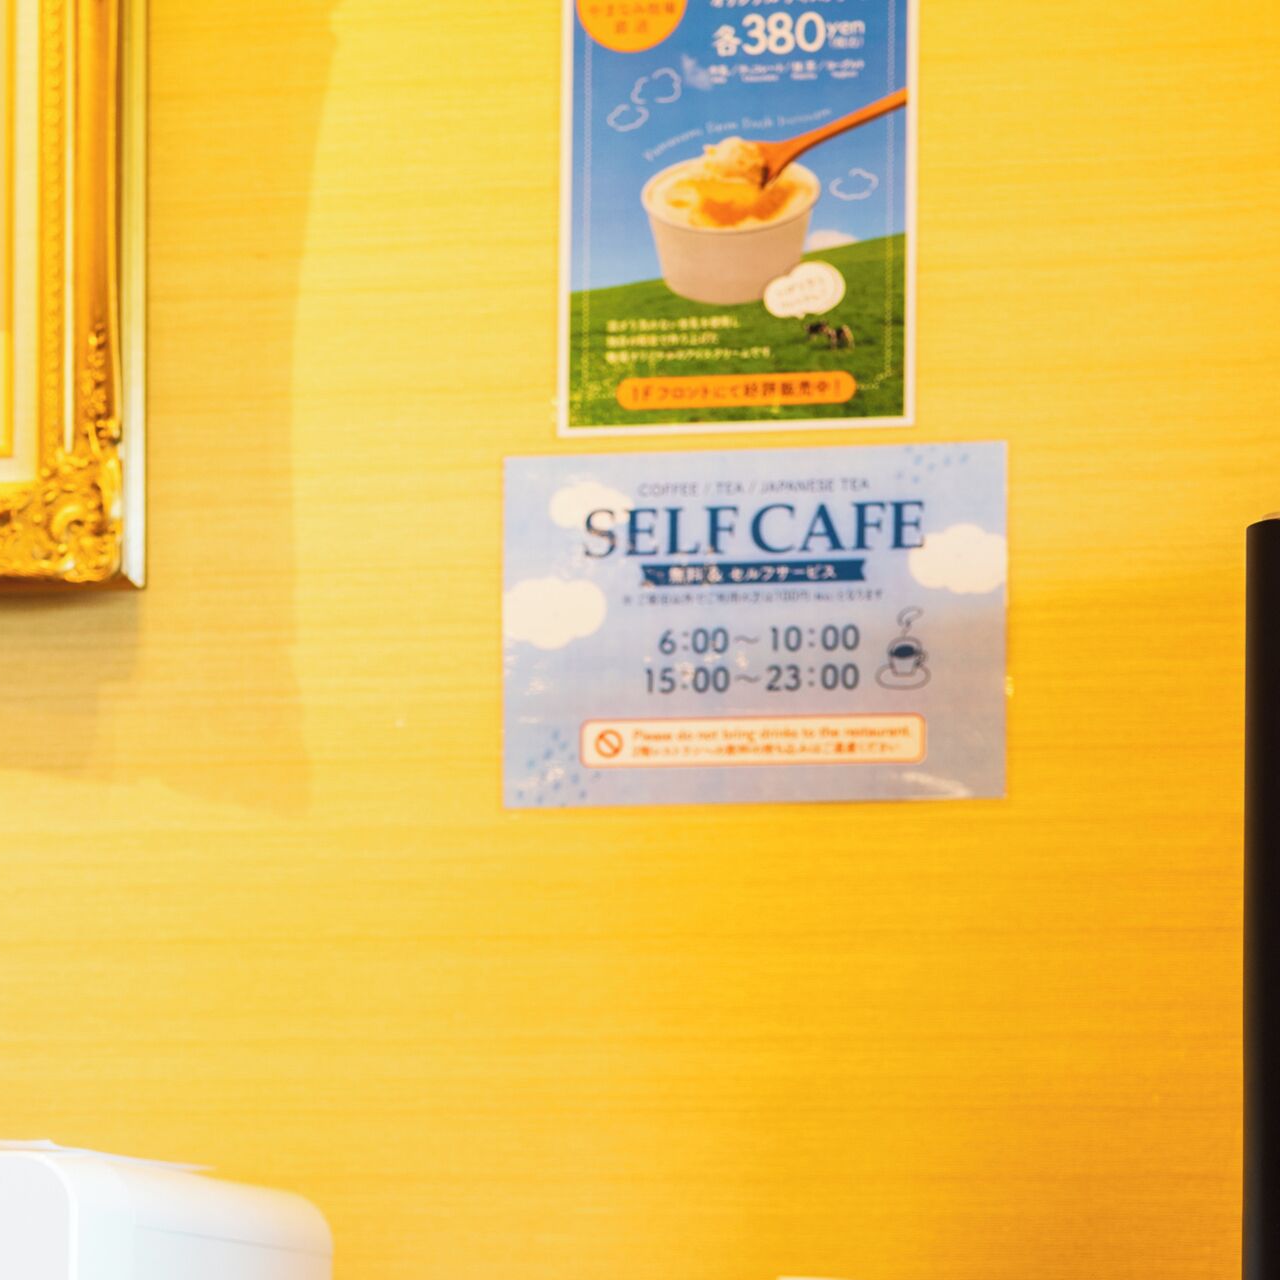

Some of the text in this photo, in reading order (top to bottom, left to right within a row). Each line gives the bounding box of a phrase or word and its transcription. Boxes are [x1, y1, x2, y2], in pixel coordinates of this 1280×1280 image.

[637, 477, 870, 497] COFFEE TEA JAPANESE TEA
[583, 501, 924, 559] SELF CAFE
